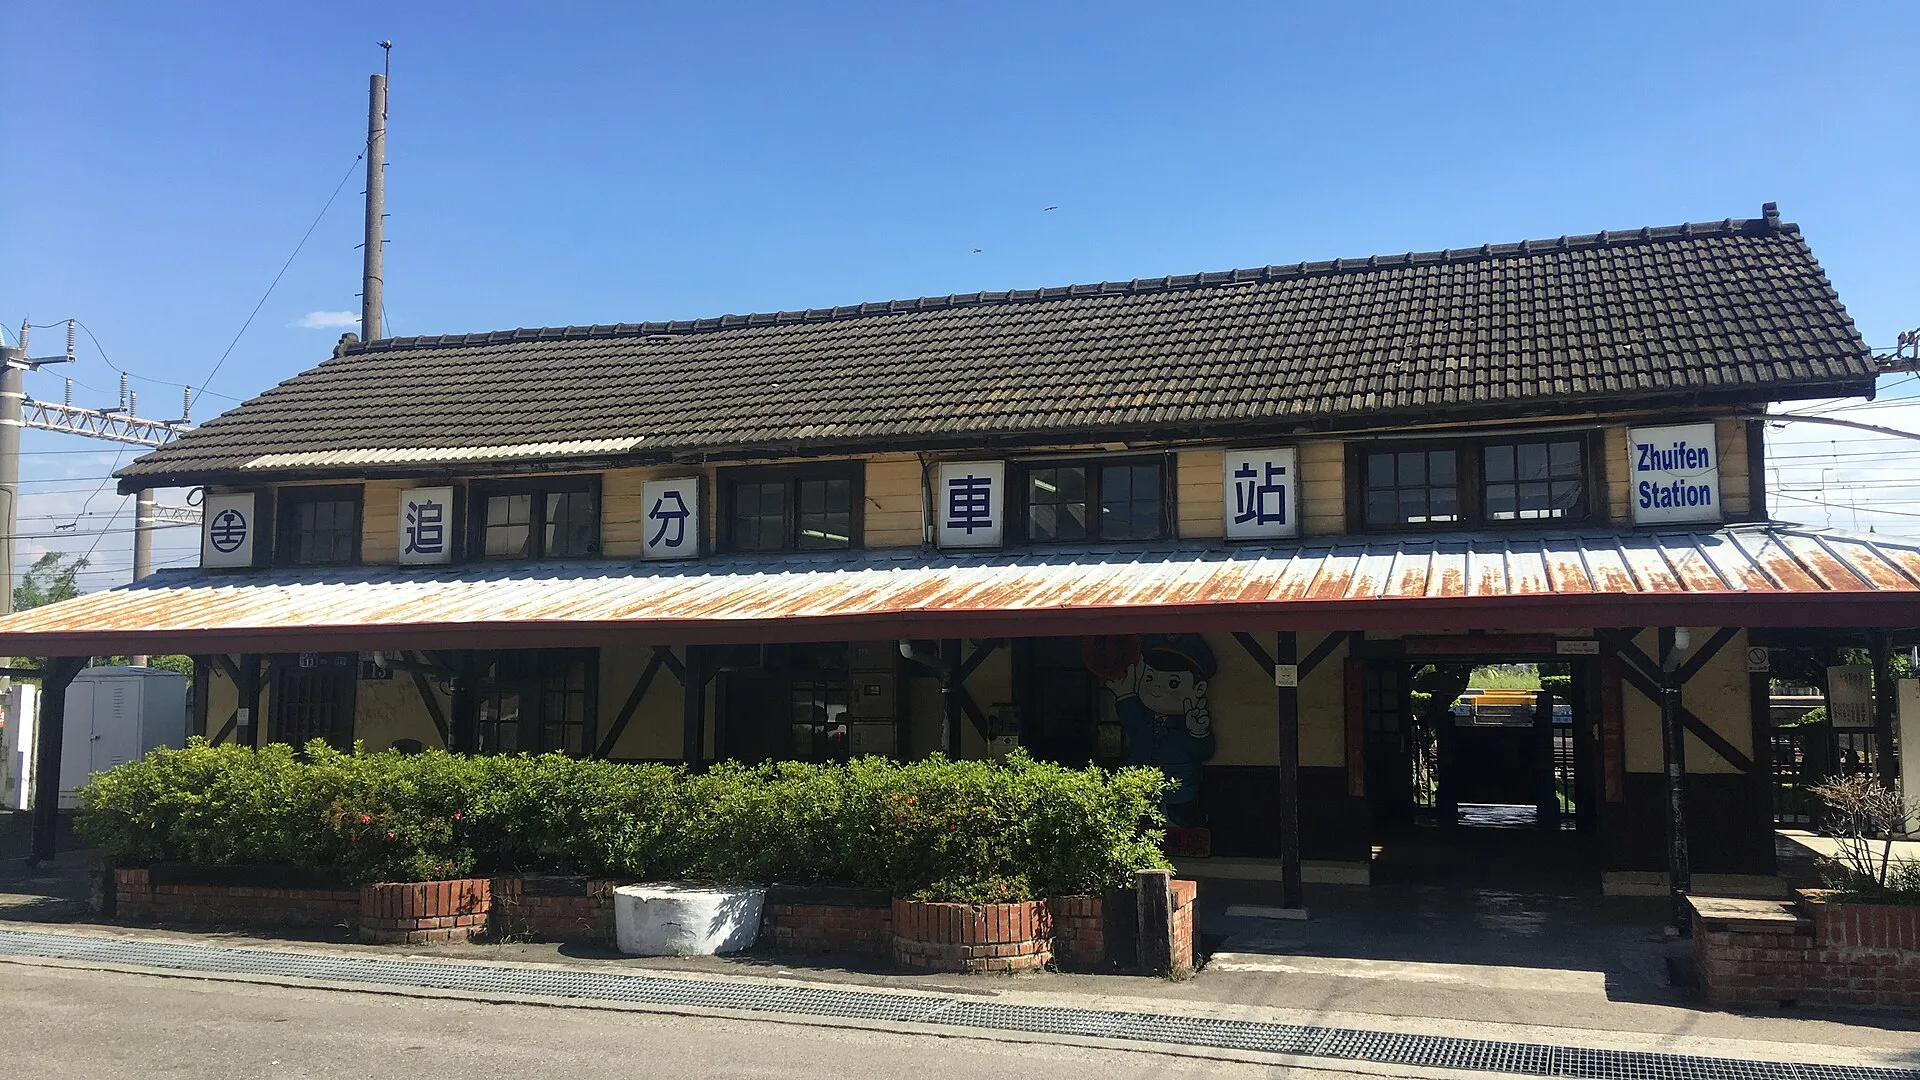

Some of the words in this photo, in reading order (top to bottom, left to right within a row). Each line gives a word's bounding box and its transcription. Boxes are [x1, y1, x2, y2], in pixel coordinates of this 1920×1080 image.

[1636, 441, 1709, 471] Zhuifen
[405, 499, 443, 555] 追
[648, 490, 691, 548] 分
[946, 474, 993, 535] 車
[1234, 461, 1286, 526] 站
[1639, 479, 1711, 509] Station
